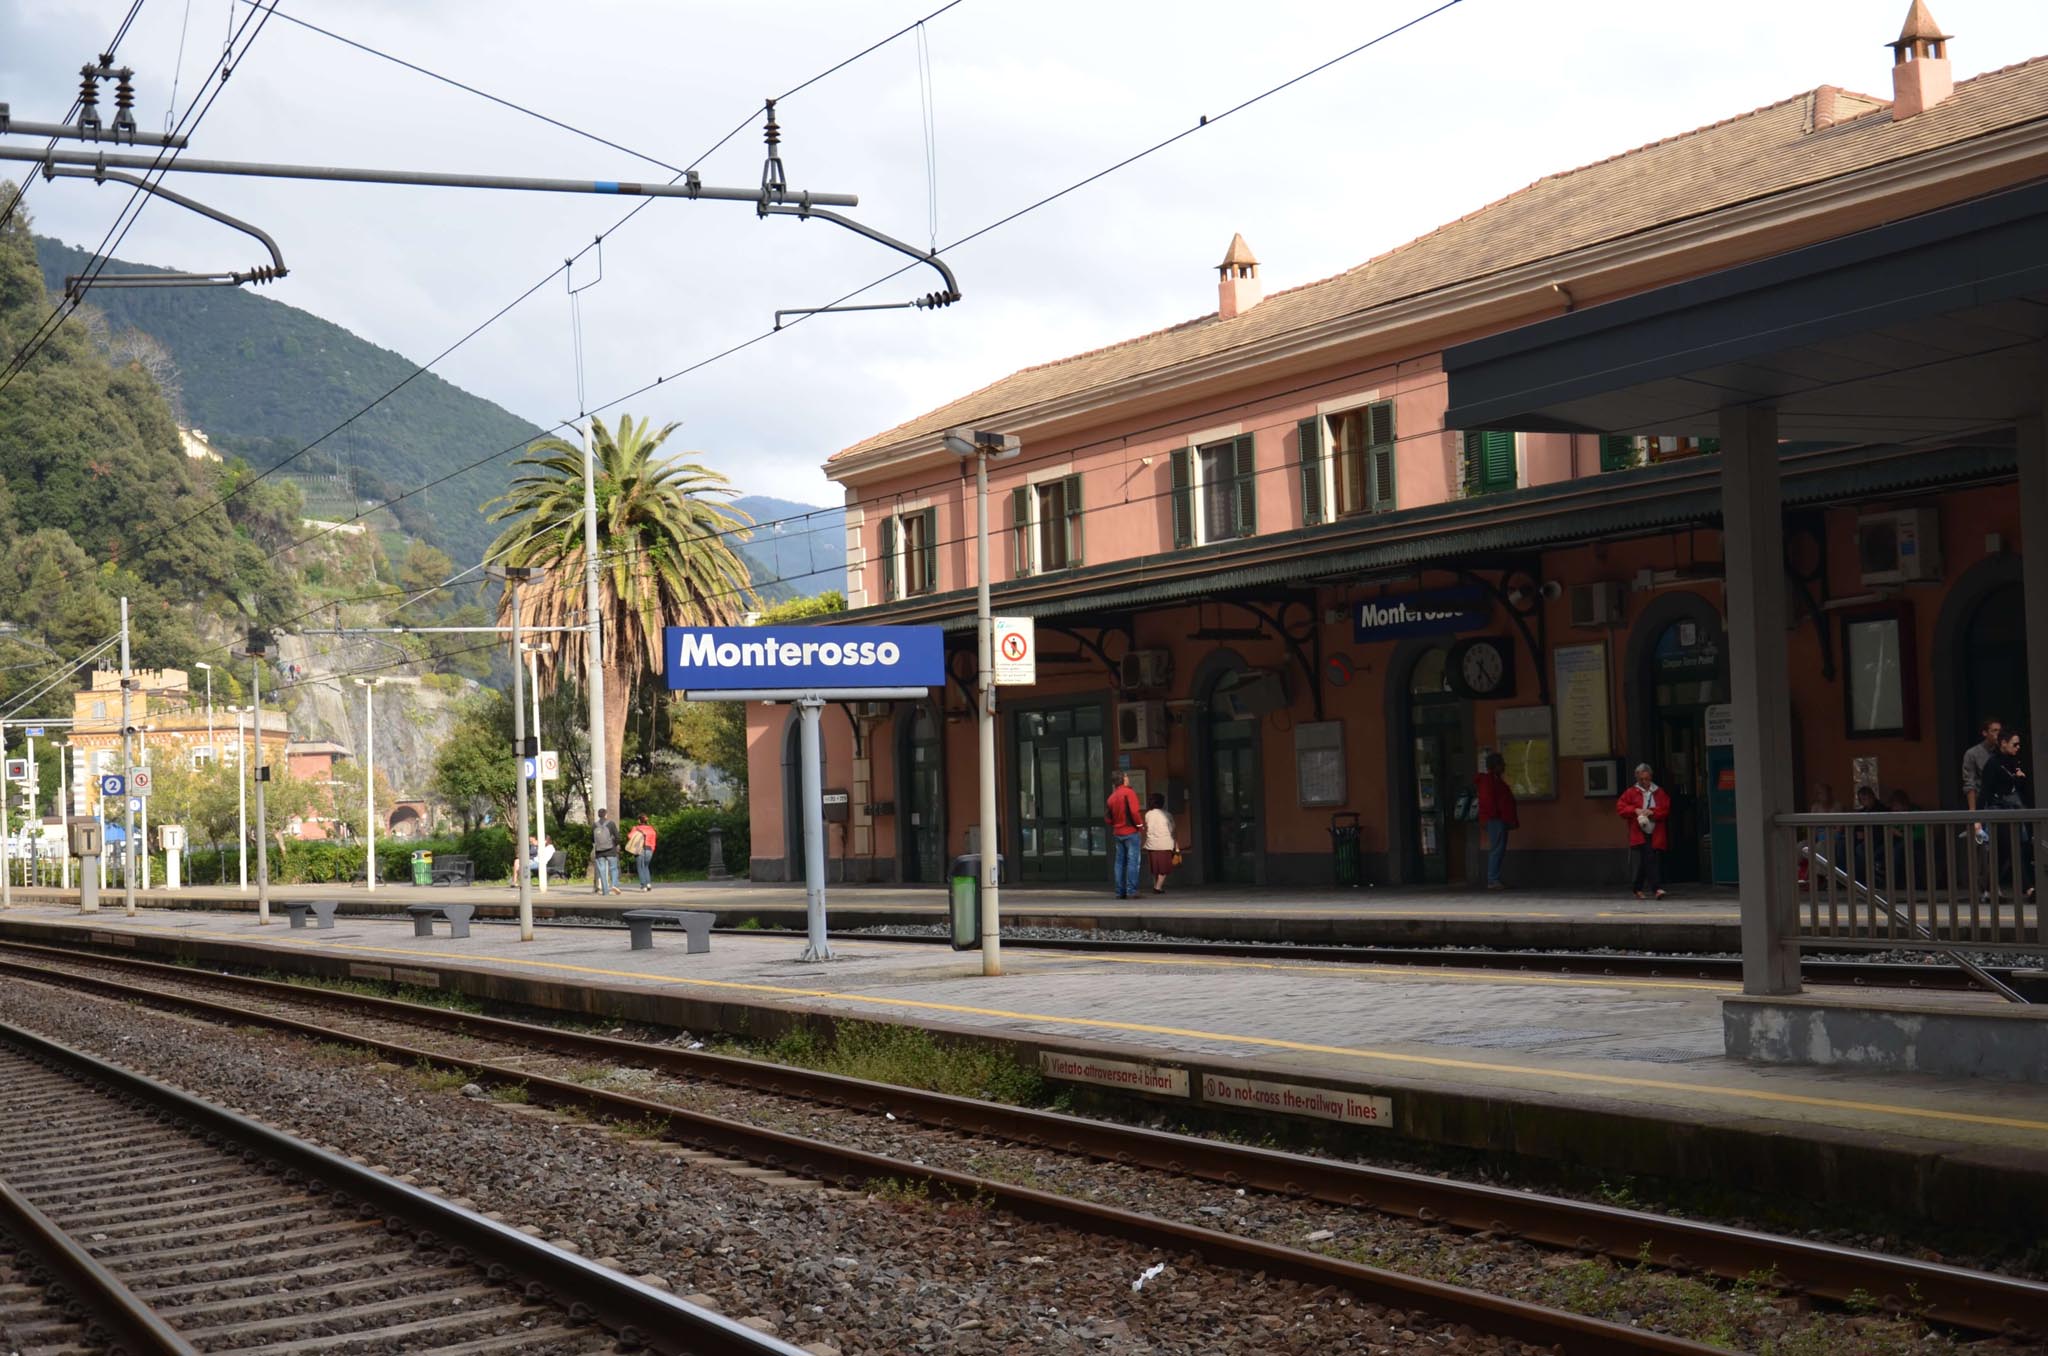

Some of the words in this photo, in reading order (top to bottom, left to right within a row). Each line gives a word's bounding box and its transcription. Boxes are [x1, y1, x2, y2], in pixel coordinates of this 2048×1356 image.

[679, 633, 900, 667] Monterosso
[108, 780, 118, 791] 2
[82, 829, 95, 850] T
[169, 831, 178, 846] T
[1051, 1059, 1083, 1076] Vietato
[1085, 1065, 1138, 1084] attraversare
[1145, 1070, 1172, 1089] binari
[1218, 1081, 1231, 1098] Do
[1235, 1086, 1253, 1101] not
[1255, 1090, 1280, 1106] cross
[1284, 1089, 1302, 1108] the
[1305, 1093, 1344, 1119] railway
[1347, 1098, 1378, 1120] lines
